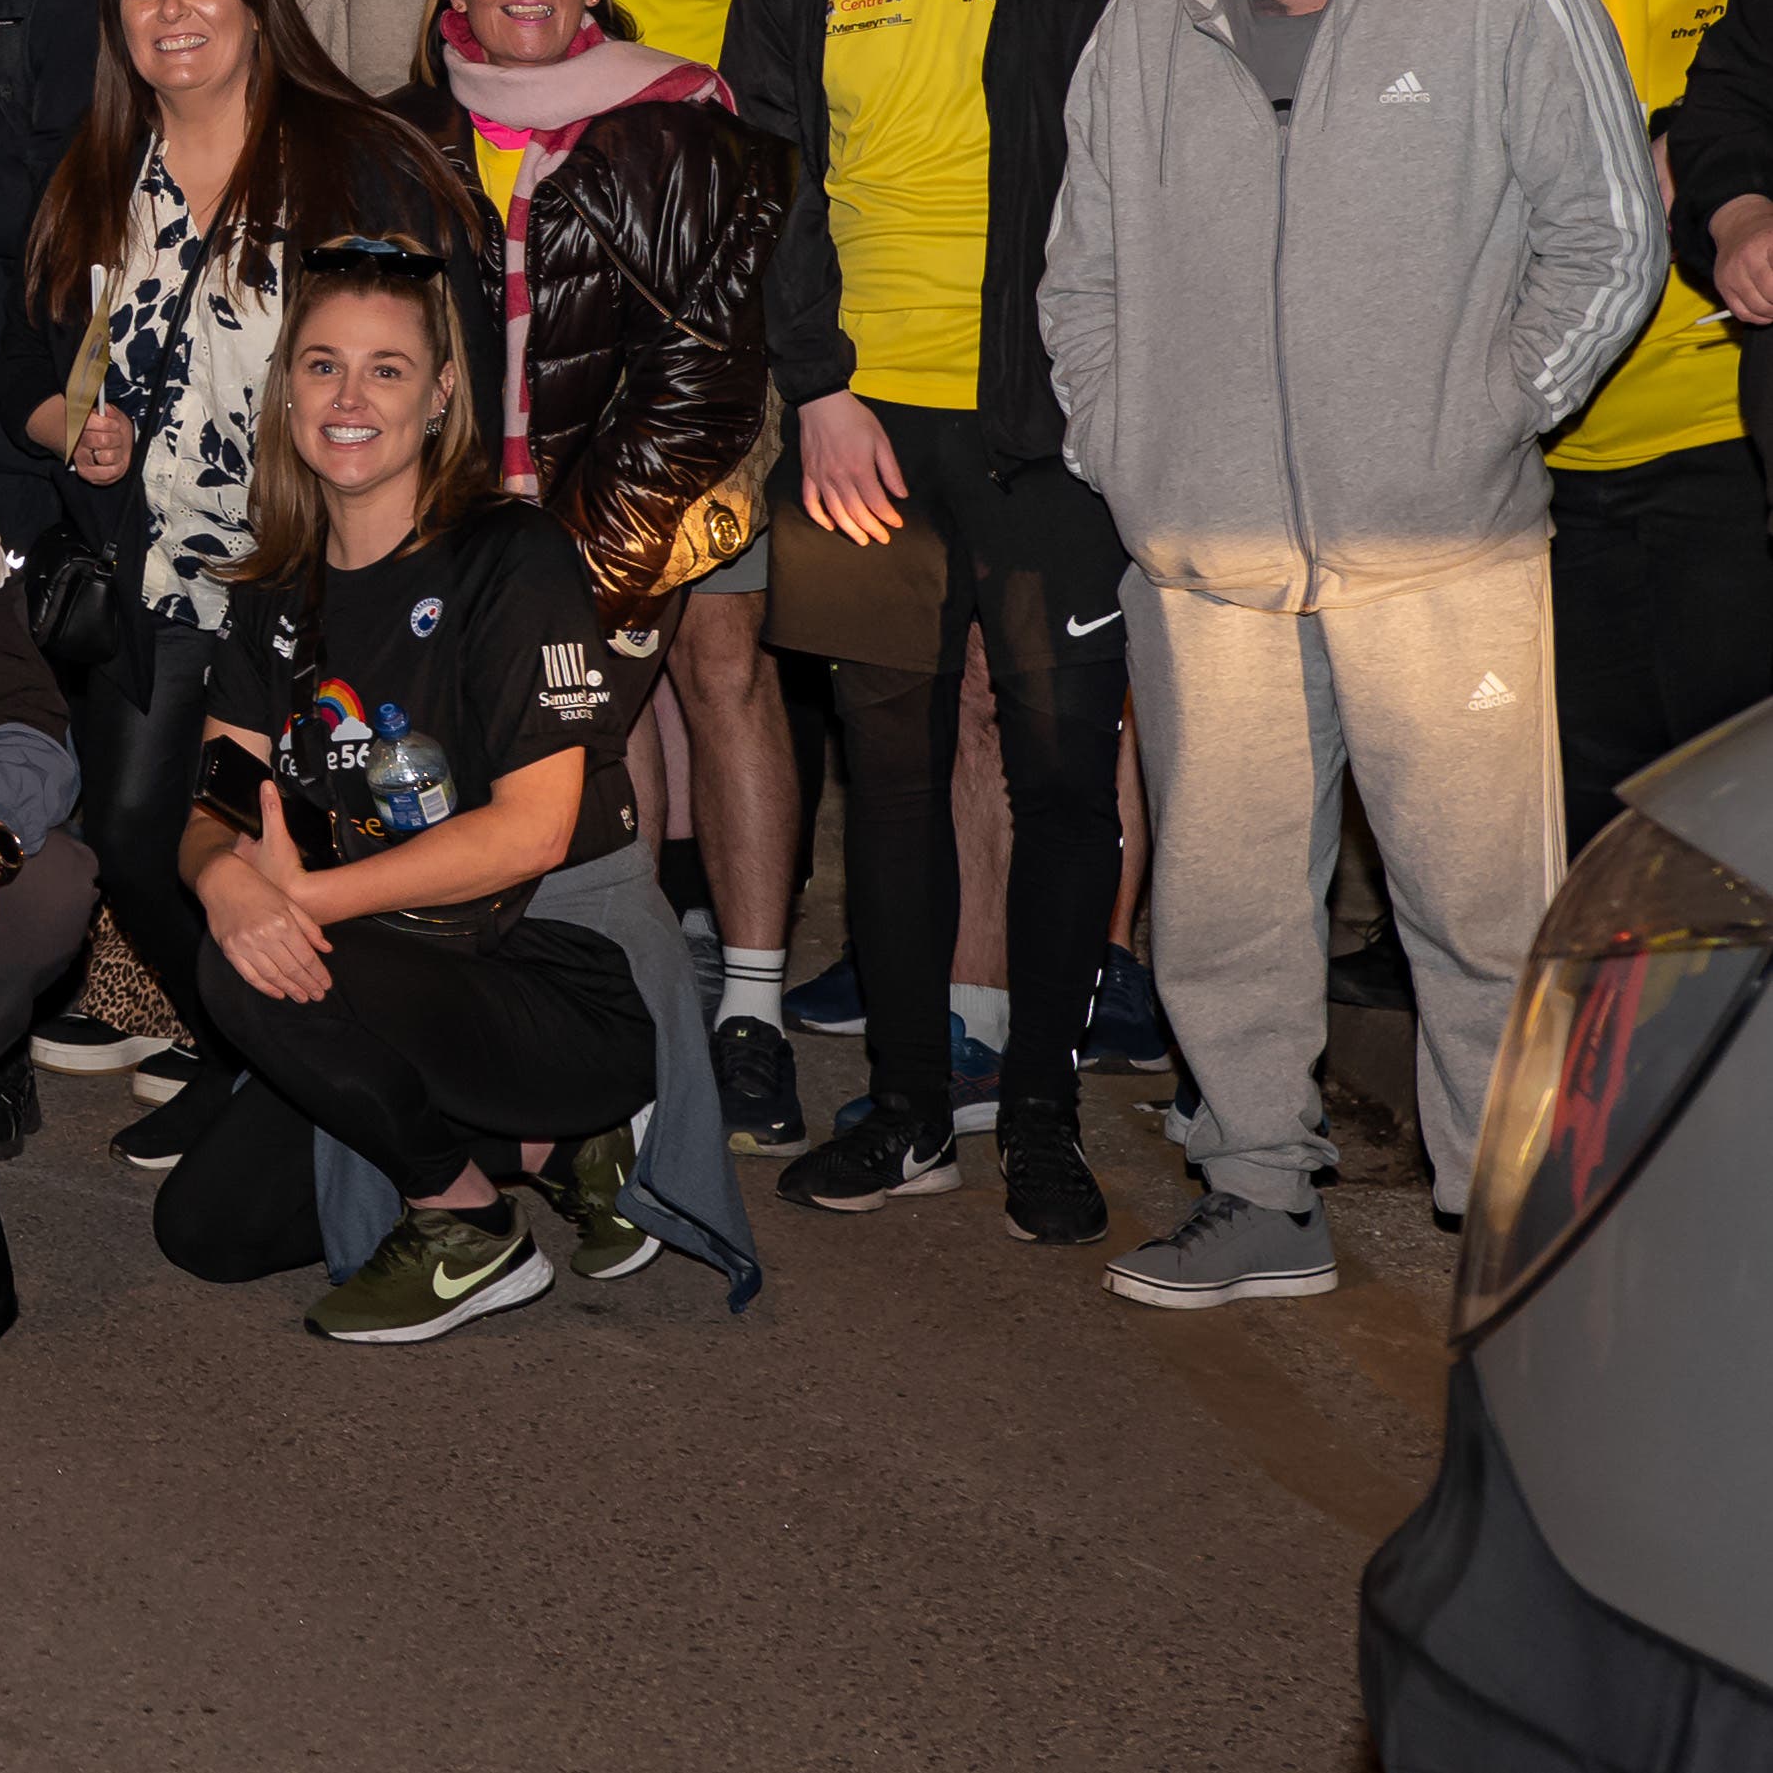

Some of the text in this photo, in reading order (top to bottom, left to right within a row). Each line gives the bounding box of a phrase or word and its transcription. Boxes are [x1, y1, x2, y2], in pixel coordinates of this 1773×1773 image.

[1379, 91, 1431, 104] adidas
[1468, 692, 1517, 711] adidas
[341, 742, 371, 769] 56
